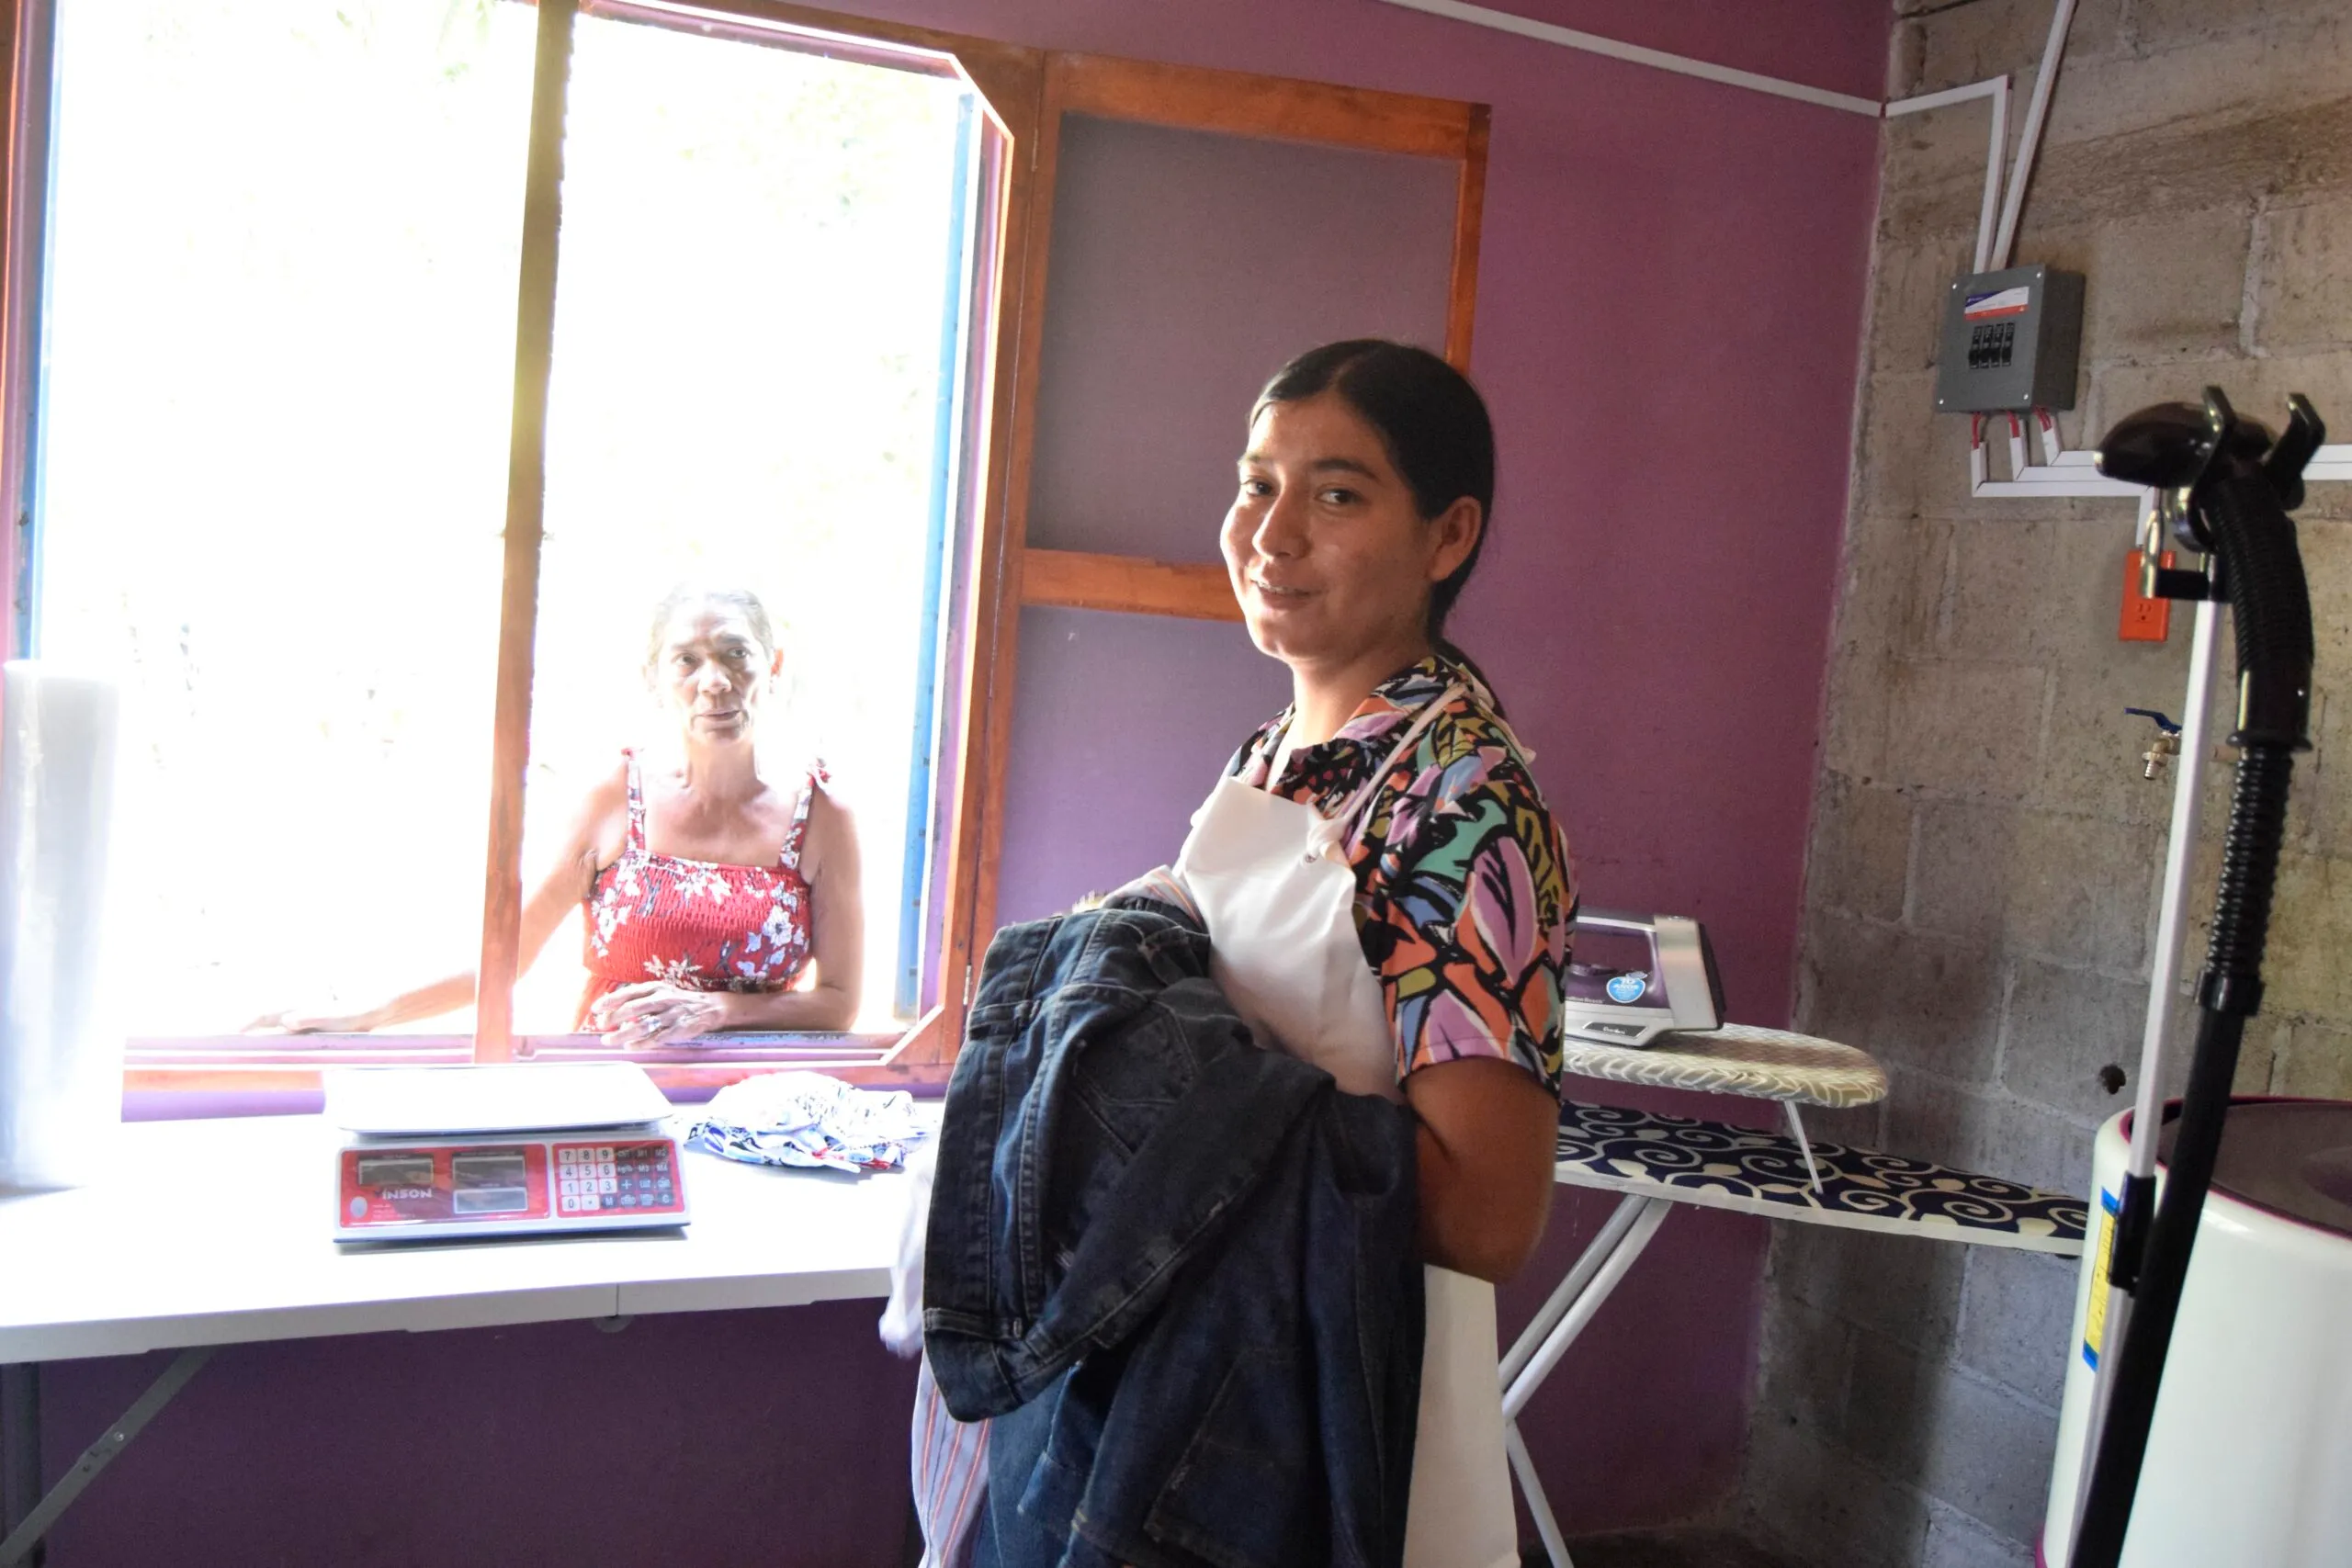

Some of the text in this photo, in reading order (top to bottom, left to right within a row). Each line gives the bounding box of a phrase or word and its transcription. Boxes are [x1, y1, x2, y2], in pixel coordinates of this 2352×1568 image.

[564, 1151, 571, 1160] 7
[583, 1150, 590, 1160] 8
[602, 1149, 608, 1159] 9
[566, 1167, 572, 1177] 4
[584, 1166, 592, 1176] 5
[603, 1165, 610, 1175] 6
[568, 1183, 573, 1193] 1
[586, 1182, 593, 1192] 2
[605, 1180, 612, 1191] 3
[568, 1199, 575, 1209] 0
